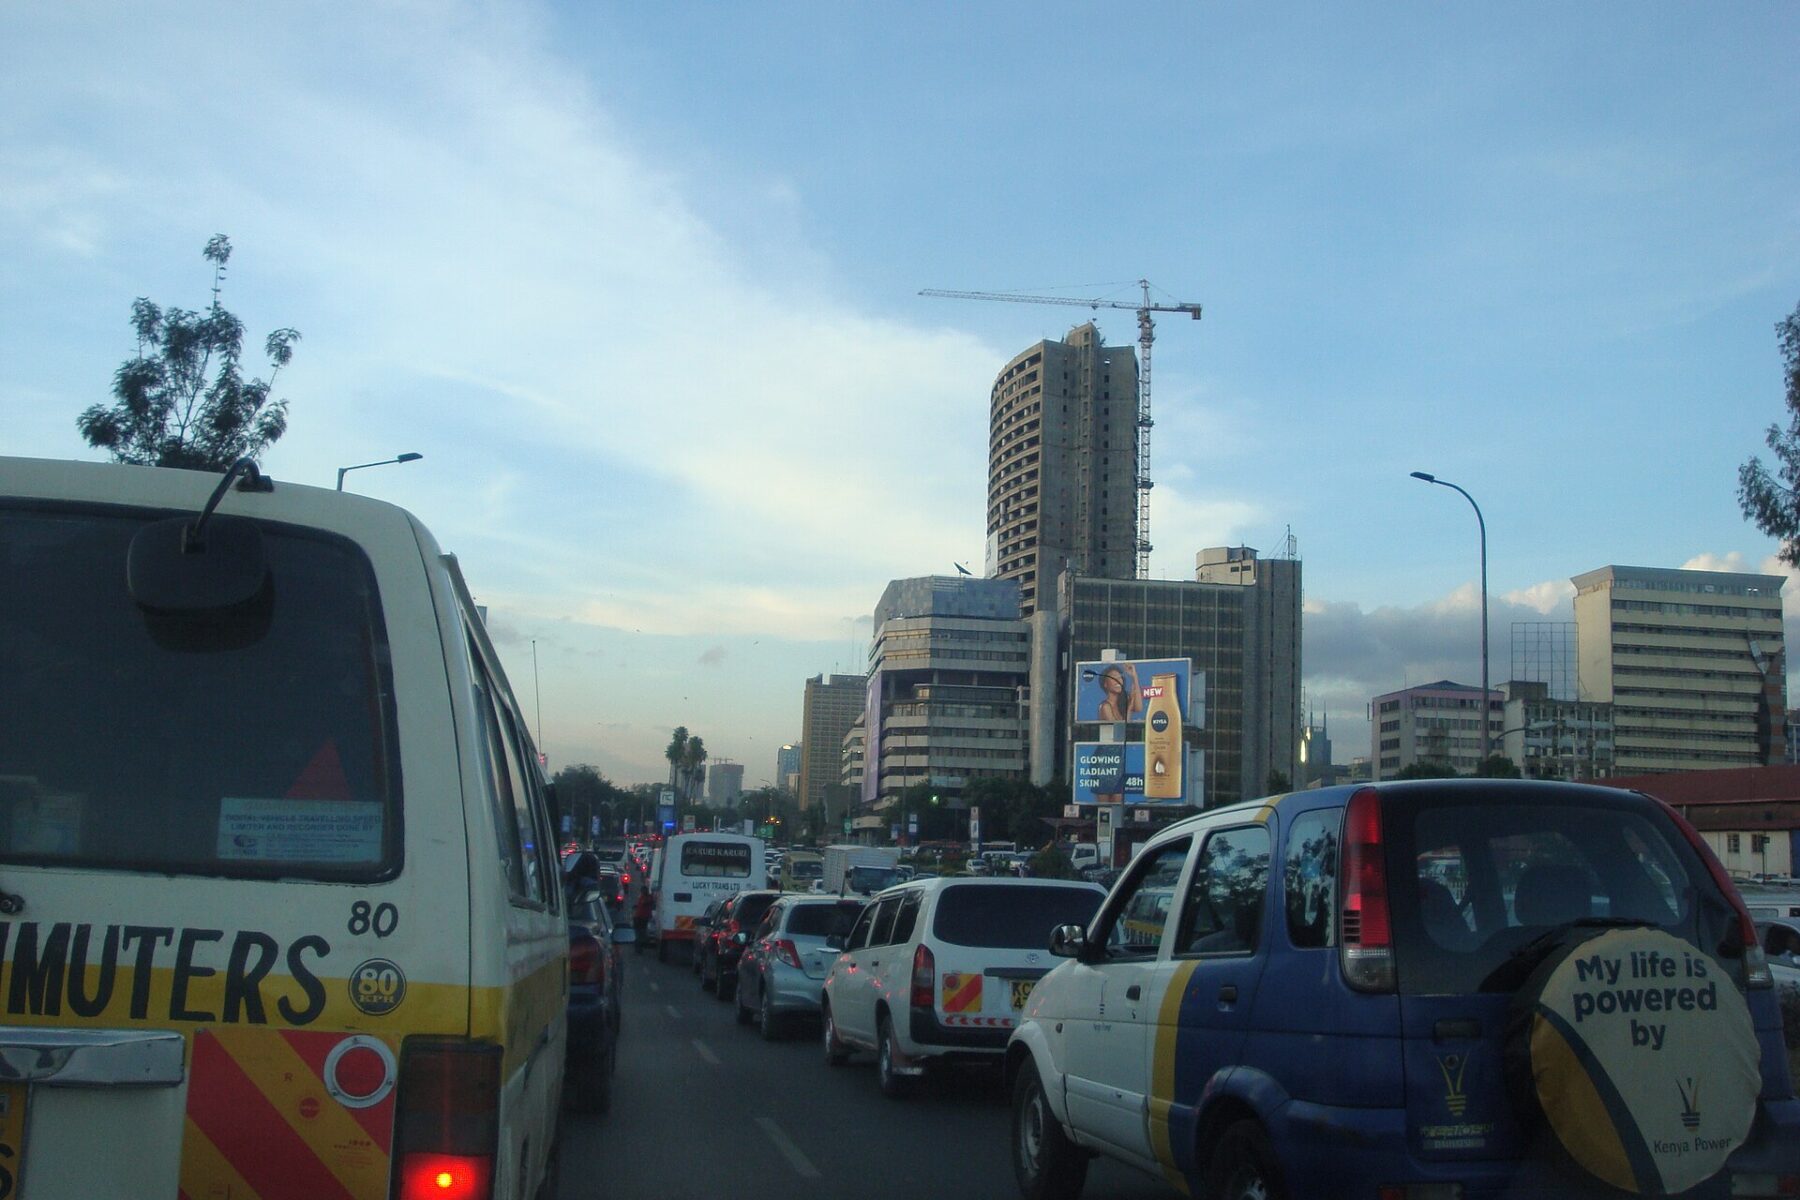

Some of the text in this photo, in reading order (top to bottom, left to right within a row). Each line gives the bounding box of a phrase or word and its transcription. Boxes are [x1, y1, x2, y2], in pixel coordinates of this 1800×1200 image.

[1143, 687, 1163, 697] NEW
[1080, 755, 1120, 764] GLOWING
[1080, 767, 1118, 776] RADIANT
[1079, 779, 1100, 787] SKIN
[1125, 777, 1143, 787] 48h
[267, 823, 285, 831] AND
[692, 881, 711, 889] LUCKY
[711, 882, 730, 890] TRANS
[348, 900, 399, 938] 80
[1575, 951, 1707, 985] My life is
[358, 968, 398, 996] 80
[1572, 981, 1718, 1022] powered
[1630, 1019, 1666, 1051] by
[284, 1072, 293, 1082] R
[1653, 1137, 1732, 1157] Kenya Power
